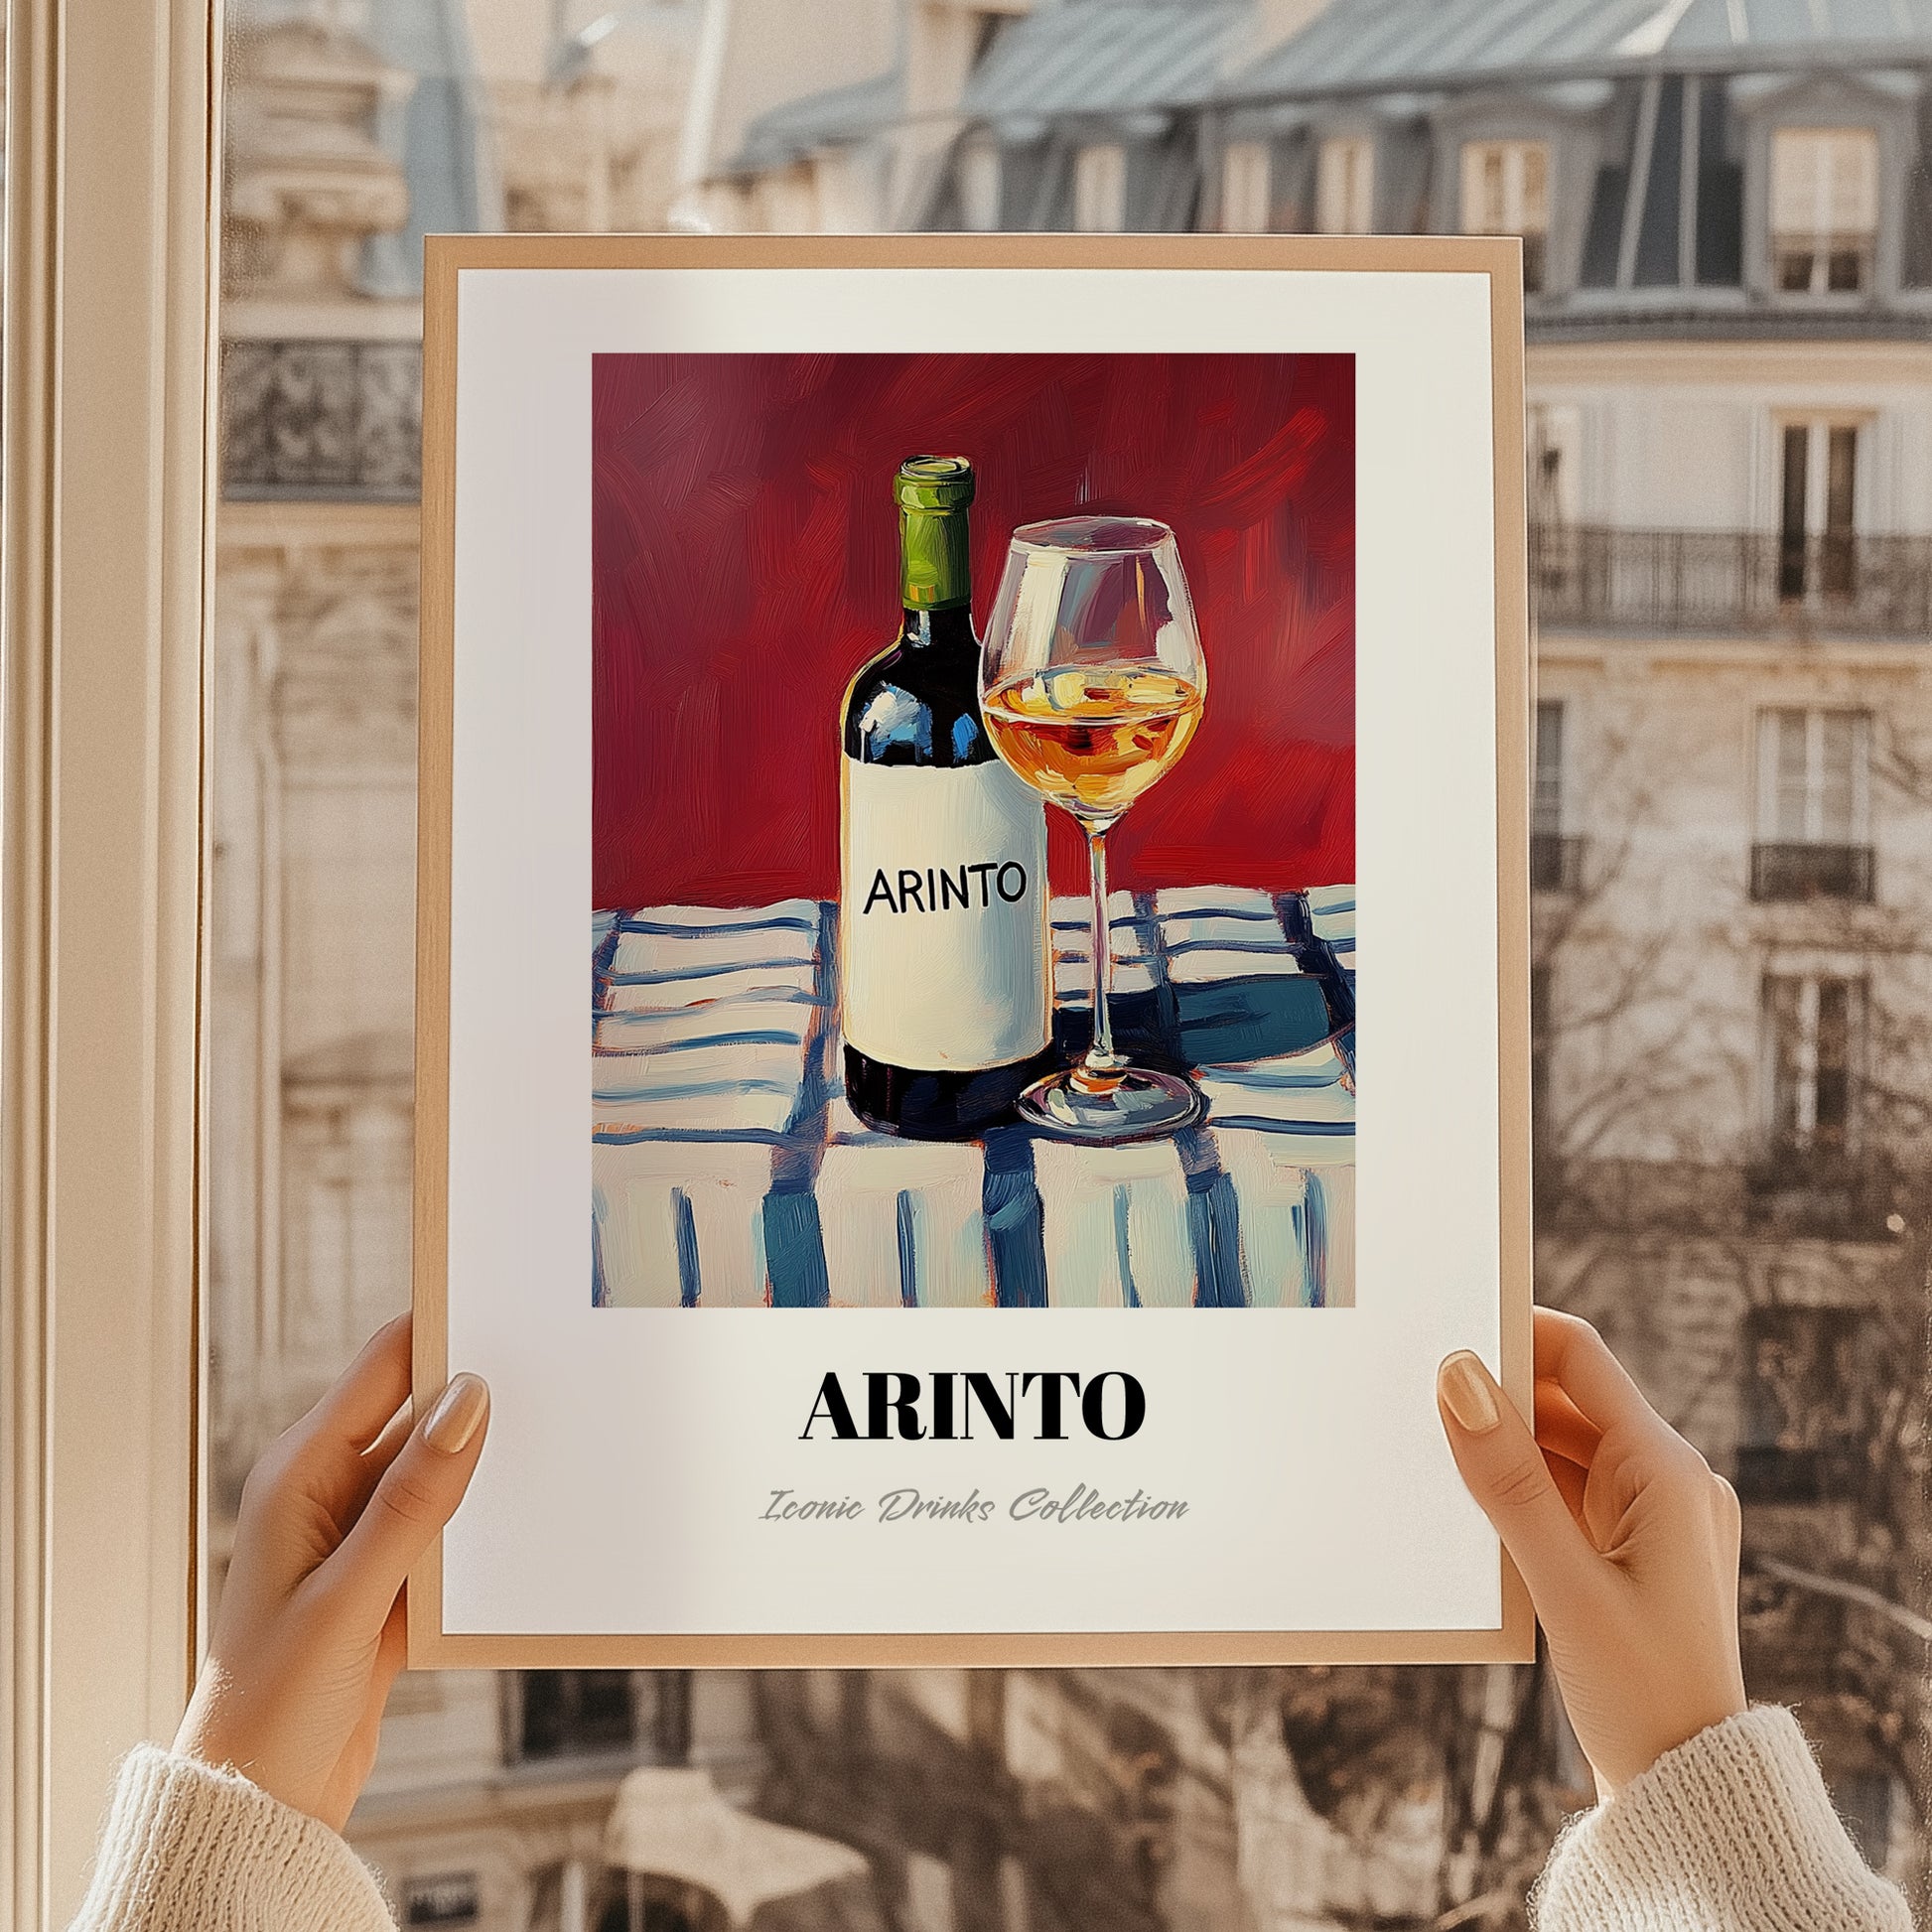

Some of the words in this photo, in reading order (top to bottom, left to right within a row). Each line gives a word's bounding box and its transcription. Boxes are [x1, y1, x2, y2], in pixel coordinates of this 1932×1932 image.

[862, 860, 1028, 915] ARINTO
[797, 1371, 1146, 1442] ARINTO
[758, 1488, 866, 1522] Iconic
[878, 1487, 996, 1524] Drinks
[1009, 1481, 1190, 1524] Collection
